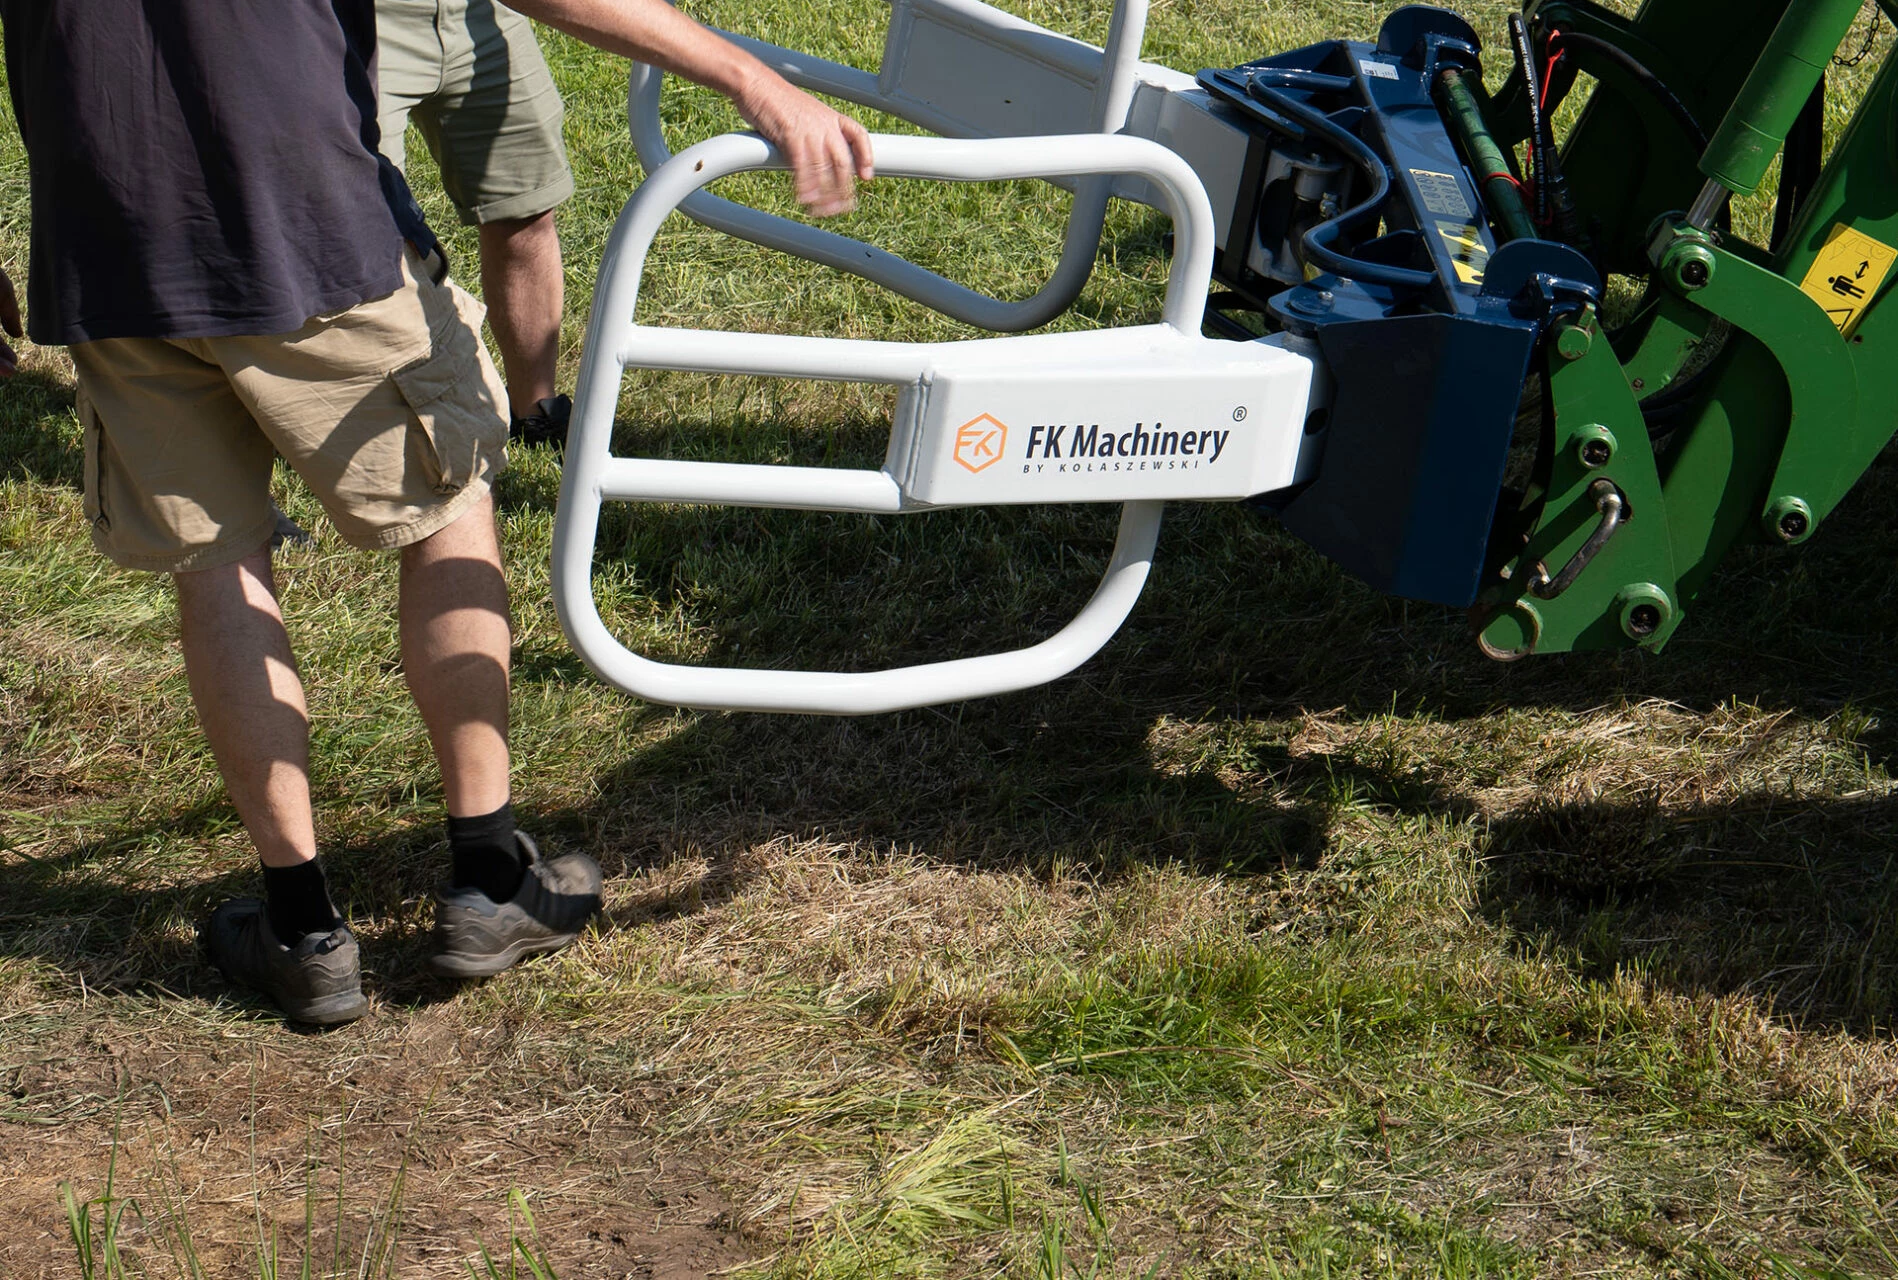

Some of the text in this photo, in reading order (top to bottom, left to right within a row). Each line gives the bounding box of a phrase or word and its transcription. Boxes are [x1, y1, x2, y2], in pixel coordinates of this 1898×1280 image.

[1026, 425, 1065, 458] FK
[1069, 422, 1230, 464] Machinery
[1023, 460, 1199, 473] BY KOŁASZEWSKI
